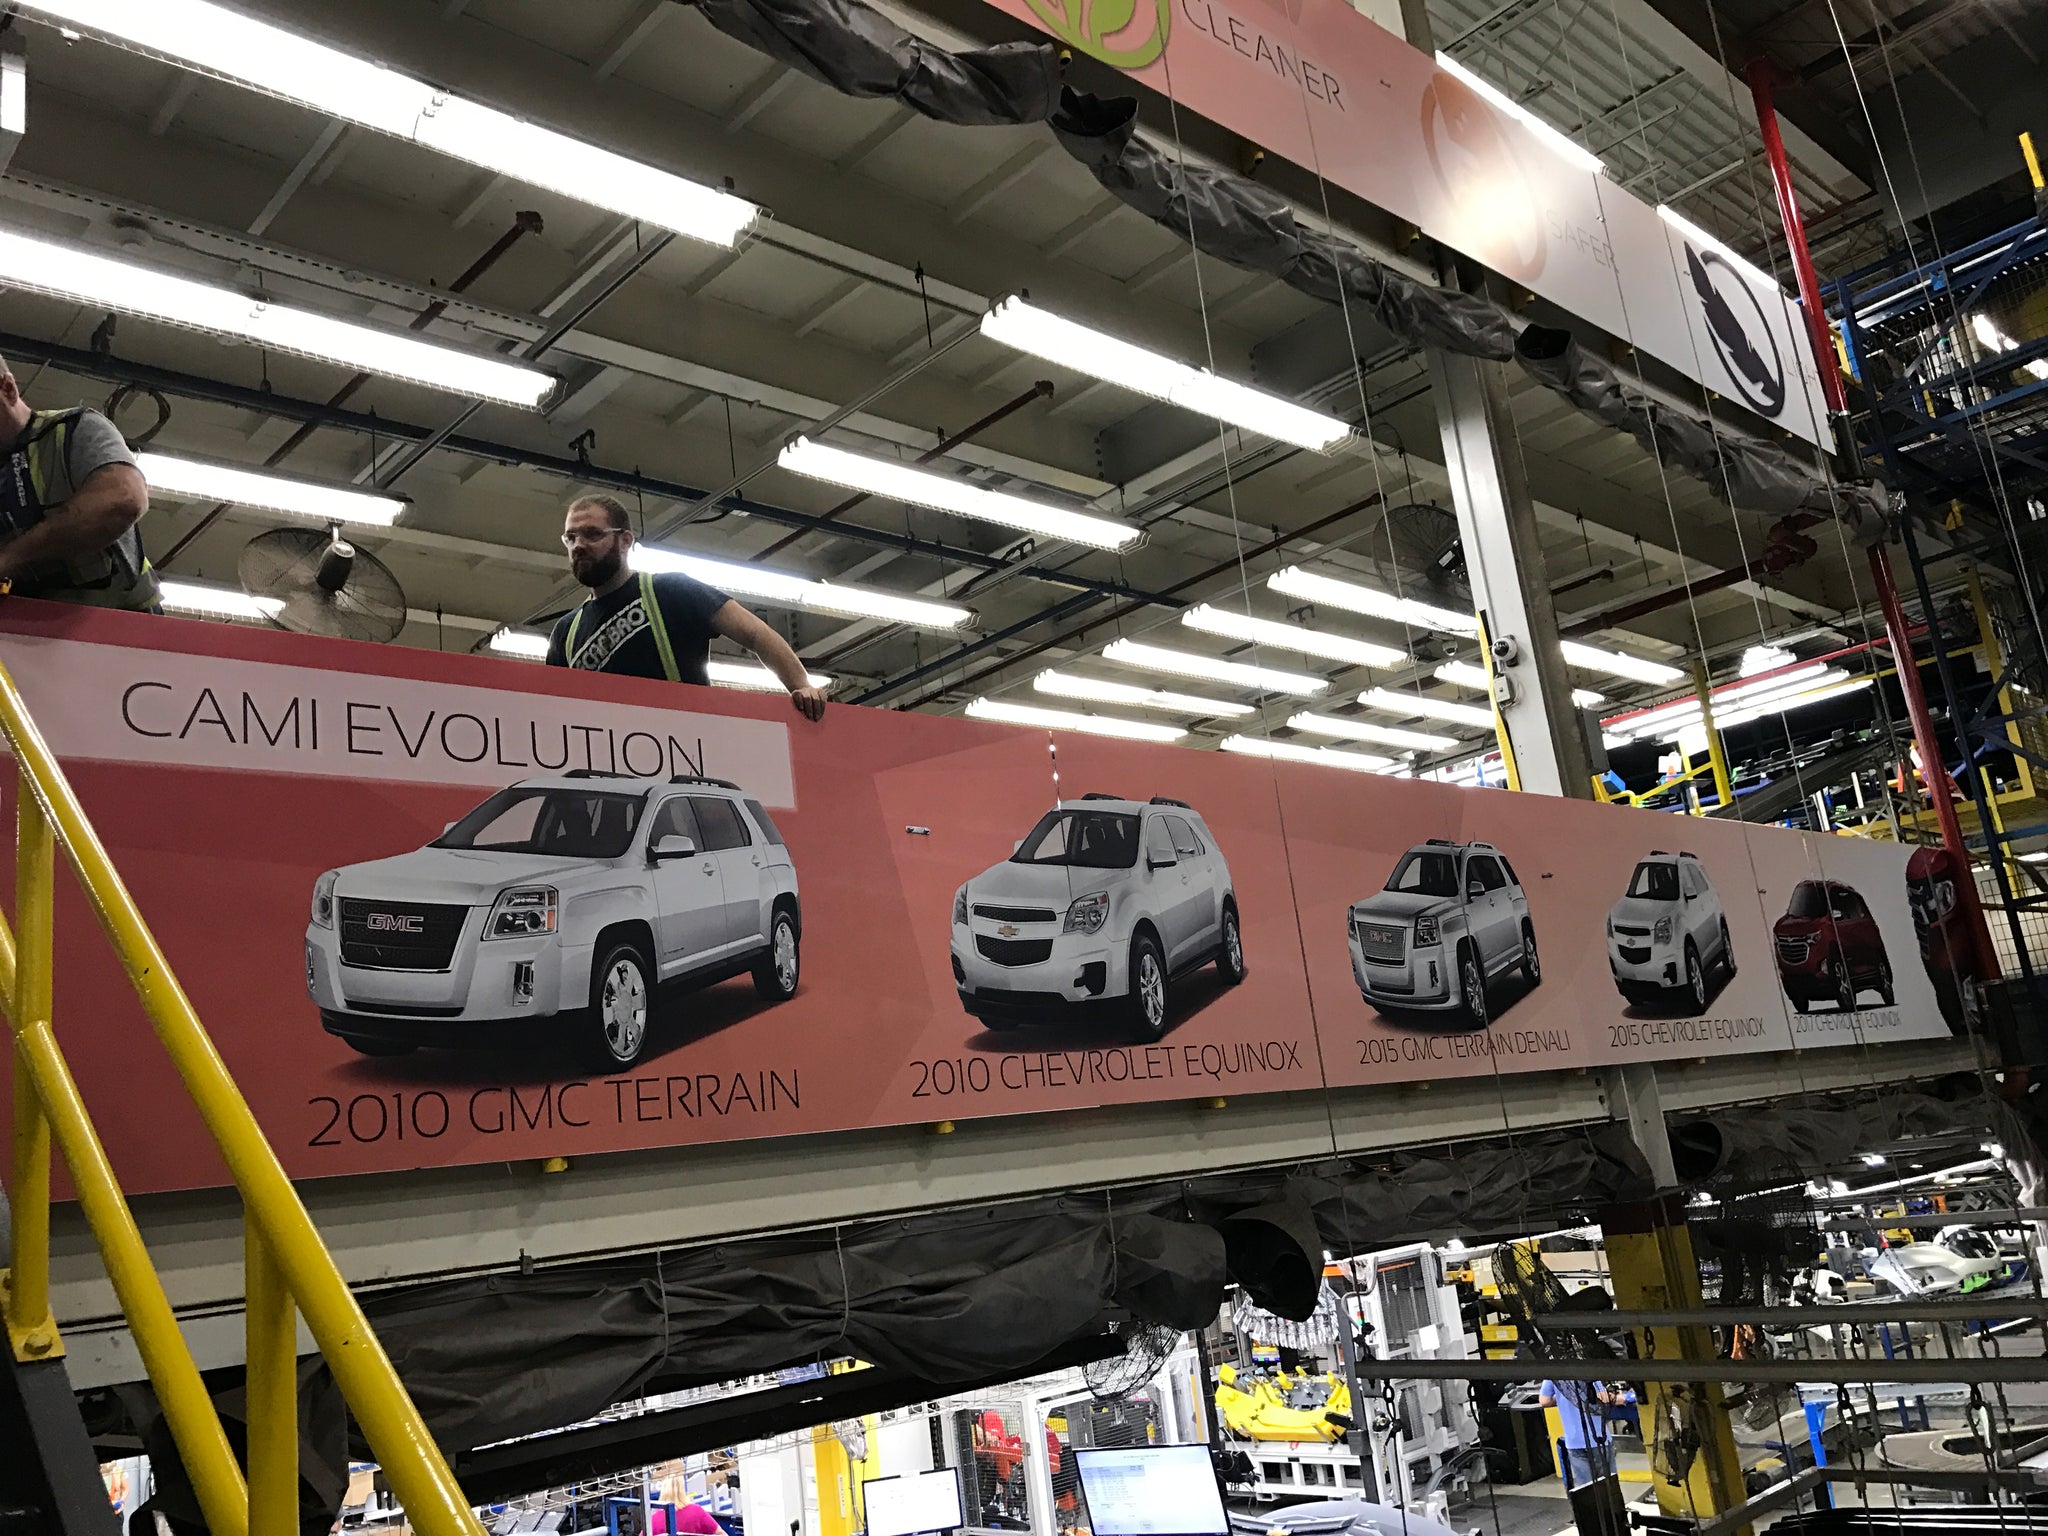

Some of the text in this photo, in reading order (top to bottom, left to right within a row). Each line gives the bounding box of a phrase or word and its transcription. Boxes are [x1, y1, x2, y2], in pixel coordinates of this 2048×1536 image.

[1181, 0, 1346, 112] CLEANER
[1546, 209, 1620, 274] SAFER
[120, 680, 705, 778] CAMI EVOLUTION
[367, 912, 424, 933] GMC
[1356, 1029, 1572, 1064] 2015 GMC TERRAIN DENALI
[1608, 1017, 1767, 1047] 2015 CHEVROLET EQUINOX
[909, 1040, 1303, 1098] 2010 CHEVROLET EQUINOX
[307, 1068, 801, 1147] 2010 GMC TERRAIN
